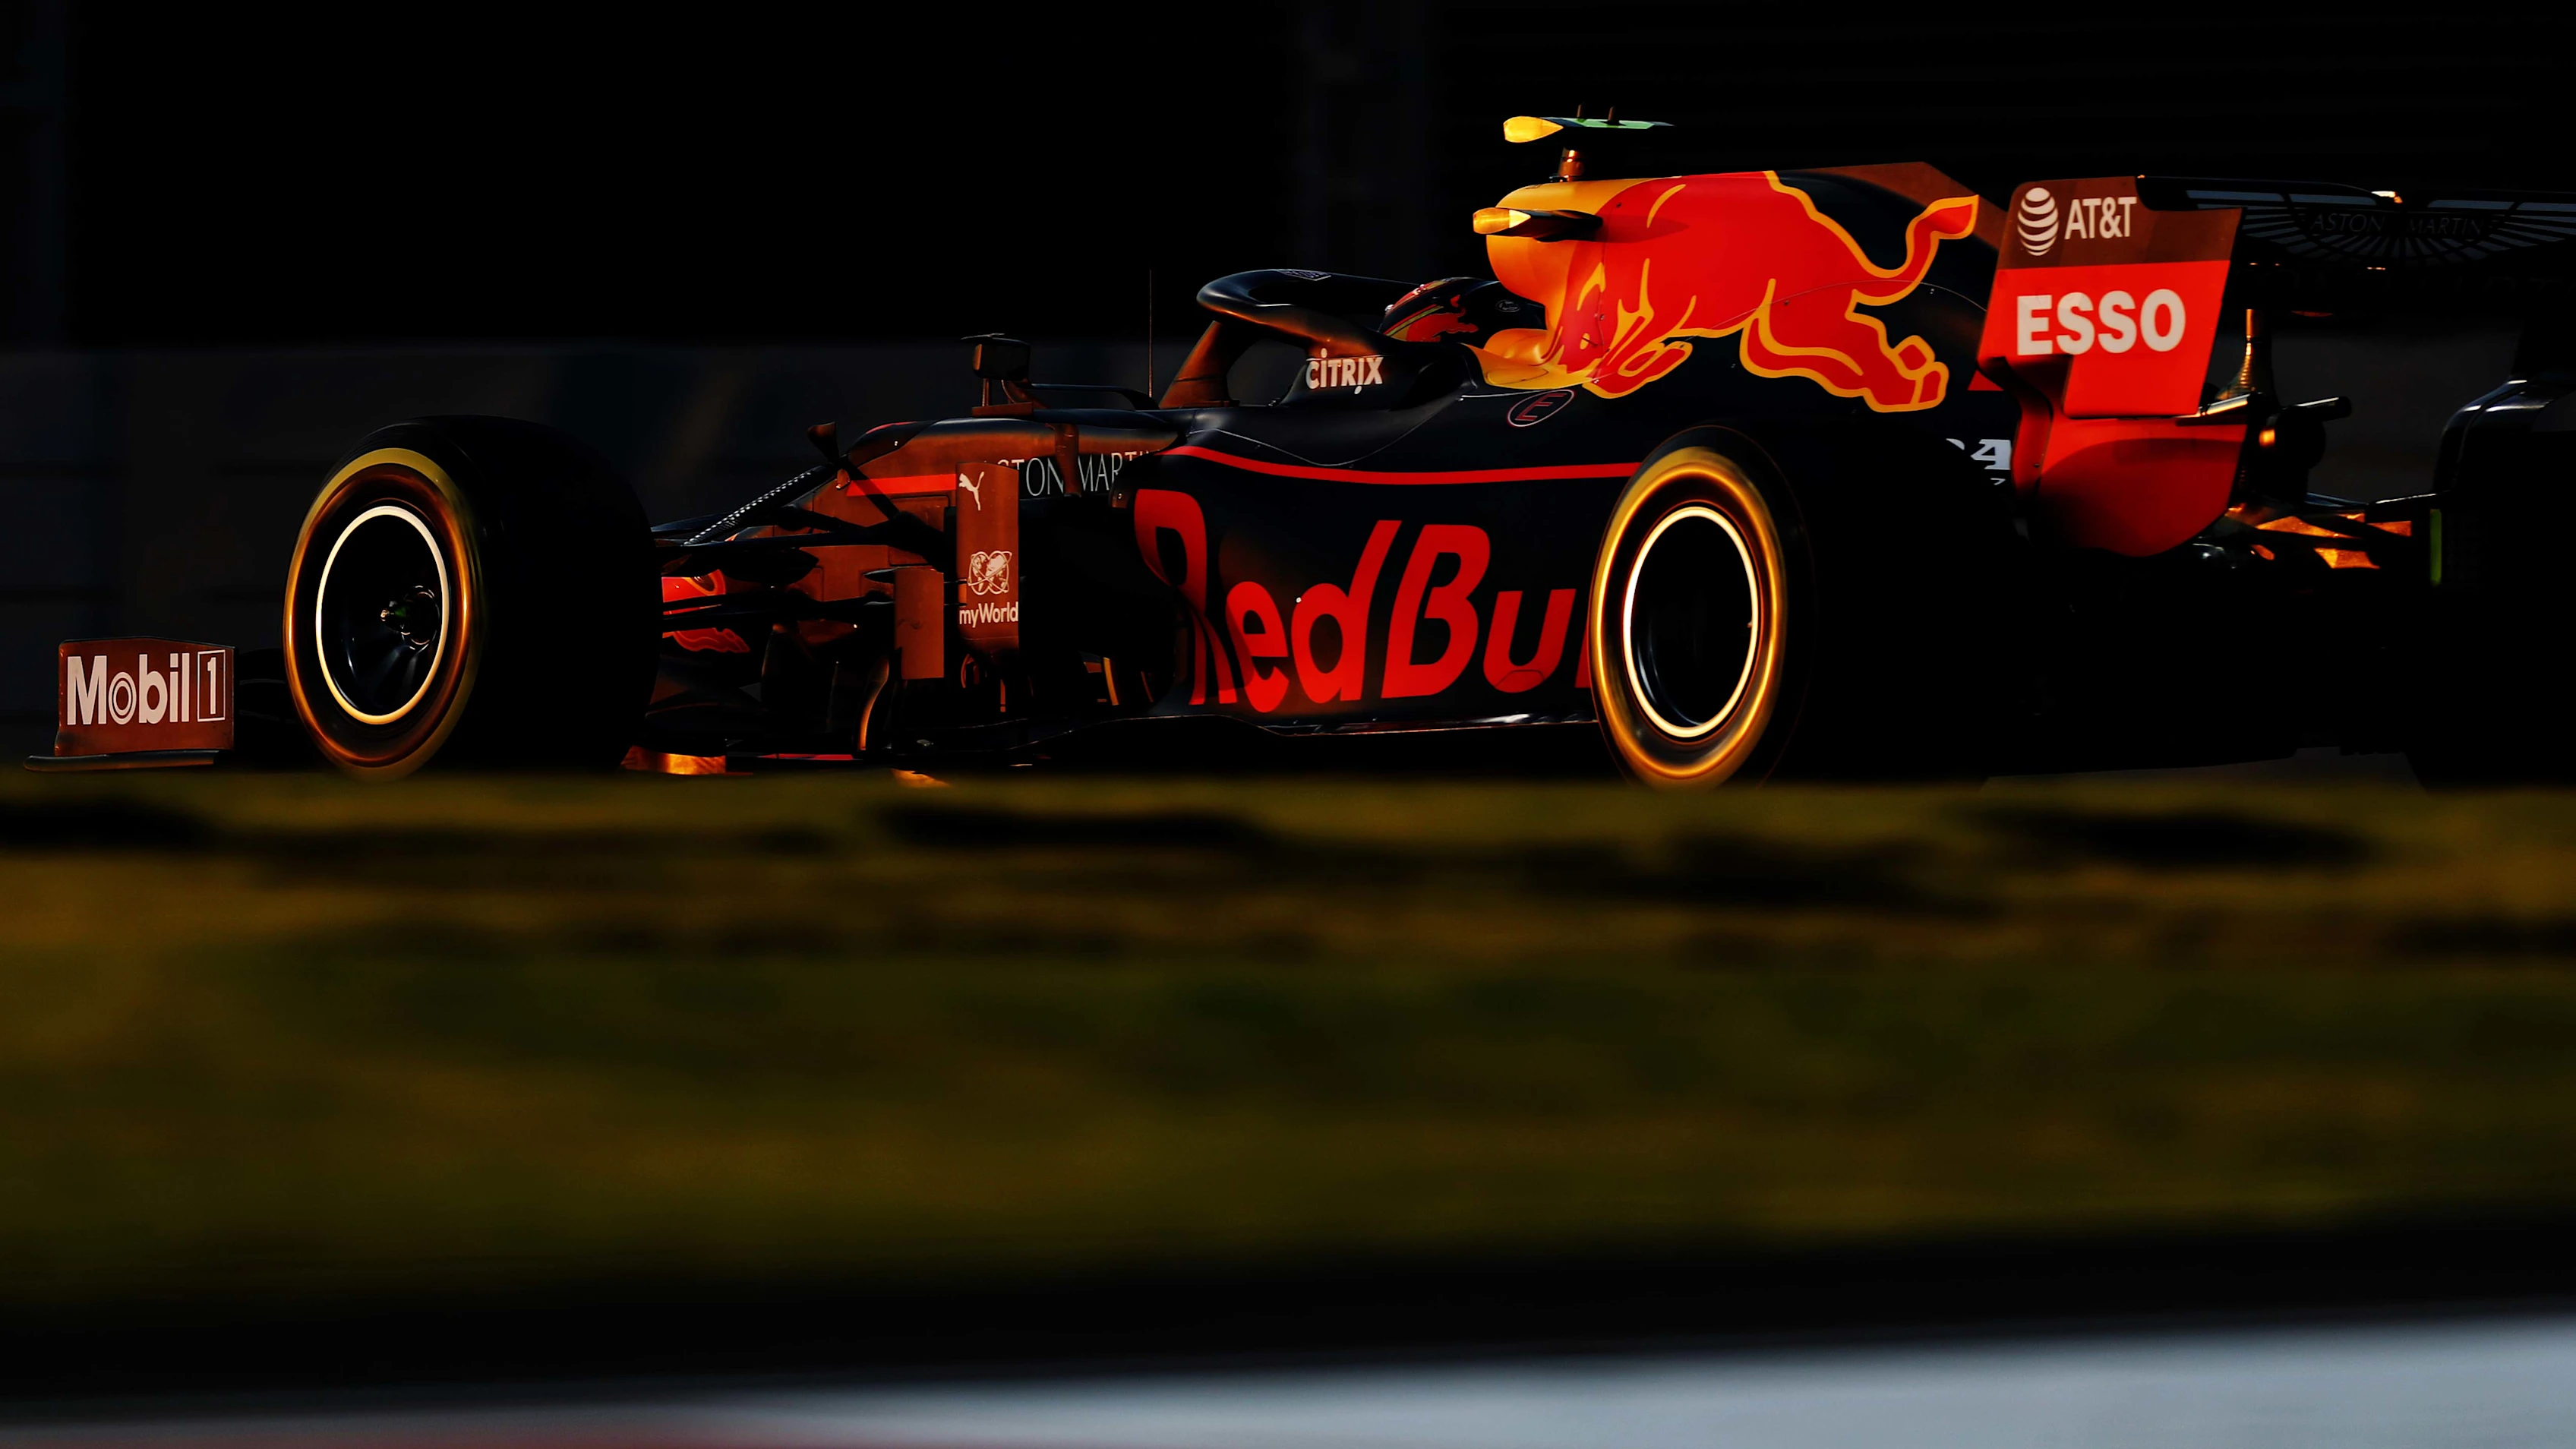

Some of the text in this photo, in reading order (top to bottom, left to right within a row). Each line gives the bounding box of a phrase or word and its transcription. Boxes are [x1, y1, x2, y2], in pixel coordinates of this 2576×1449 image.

[2064, 196, 2137, 240] AT&T
[2310, 213, 2484, 237] ASTON MARTIN
[2016, 289, 2186, 356] ESSO
[1305, 348, 1384, 395] CITRIX
[958, 601, 1019, 628] myWorld
[66, 652, 190, 725] Mobil
